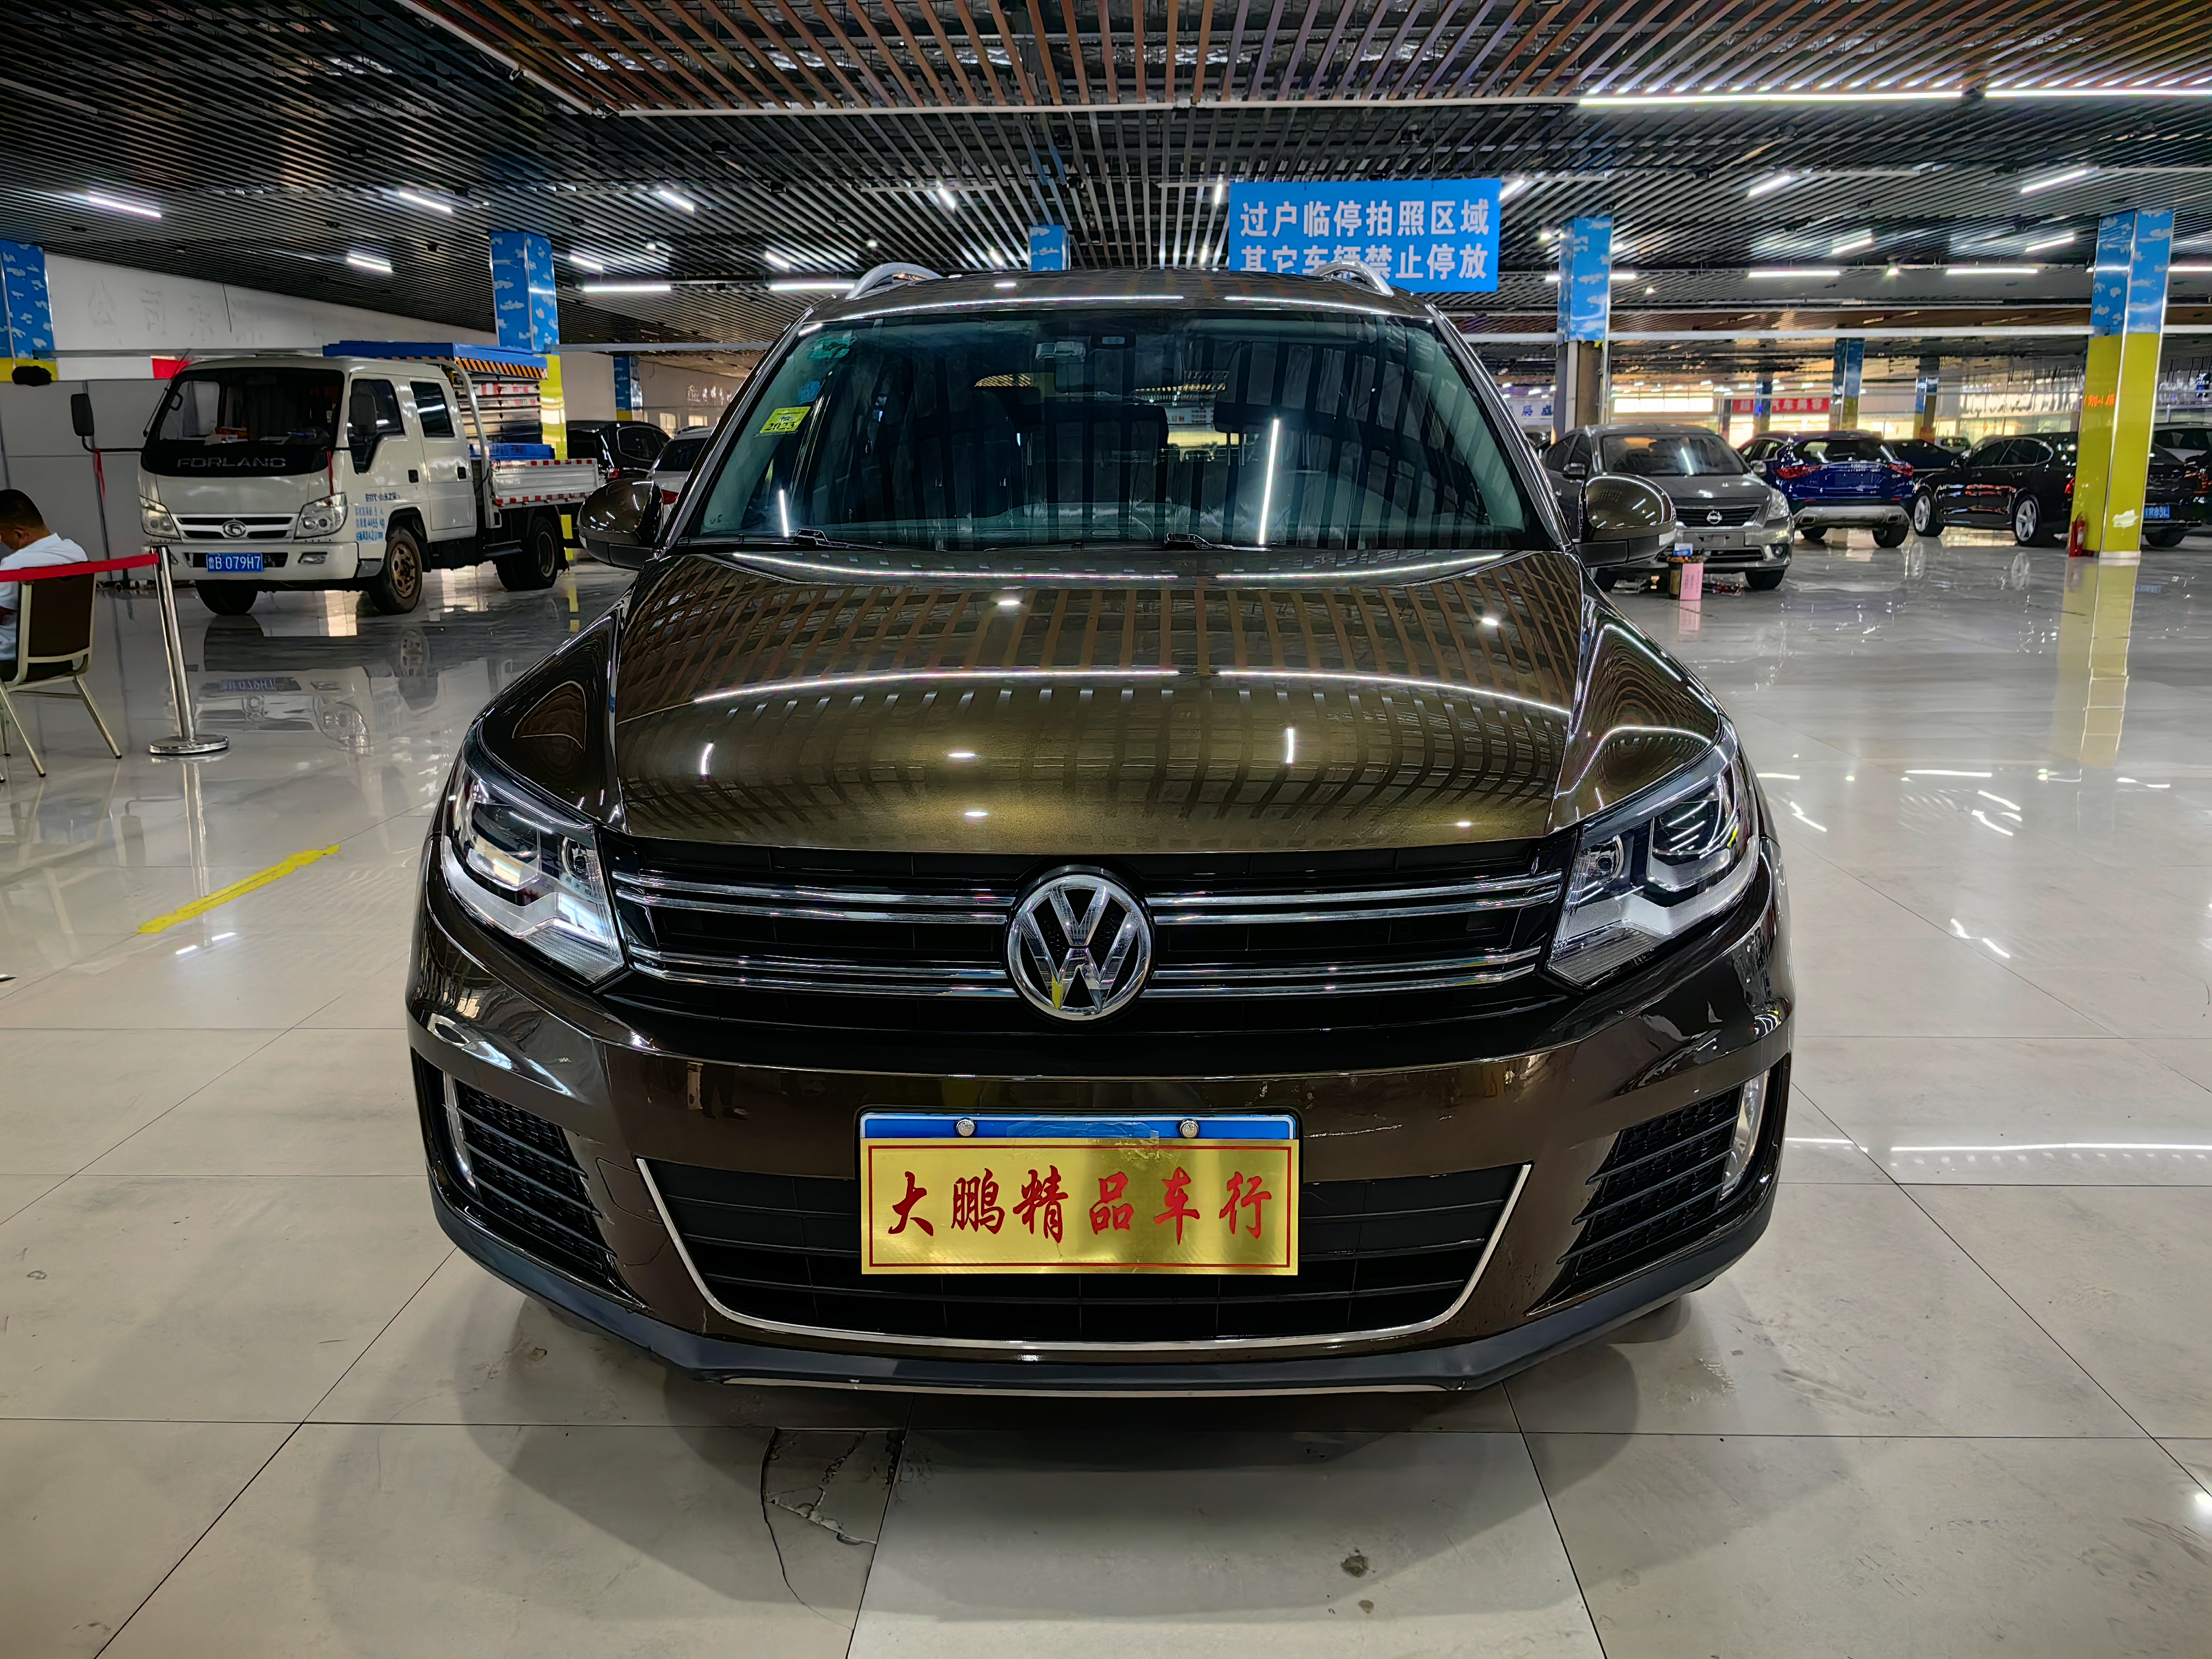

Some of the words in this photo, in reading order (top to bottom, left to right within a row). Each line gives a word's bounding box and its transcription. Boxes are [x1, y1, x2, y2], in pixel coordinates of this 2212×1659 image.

[1240, 198, 1489, 238] 过户临停拍照区域
[887, 1164, 1272, 1245] 大鹏精品车行
